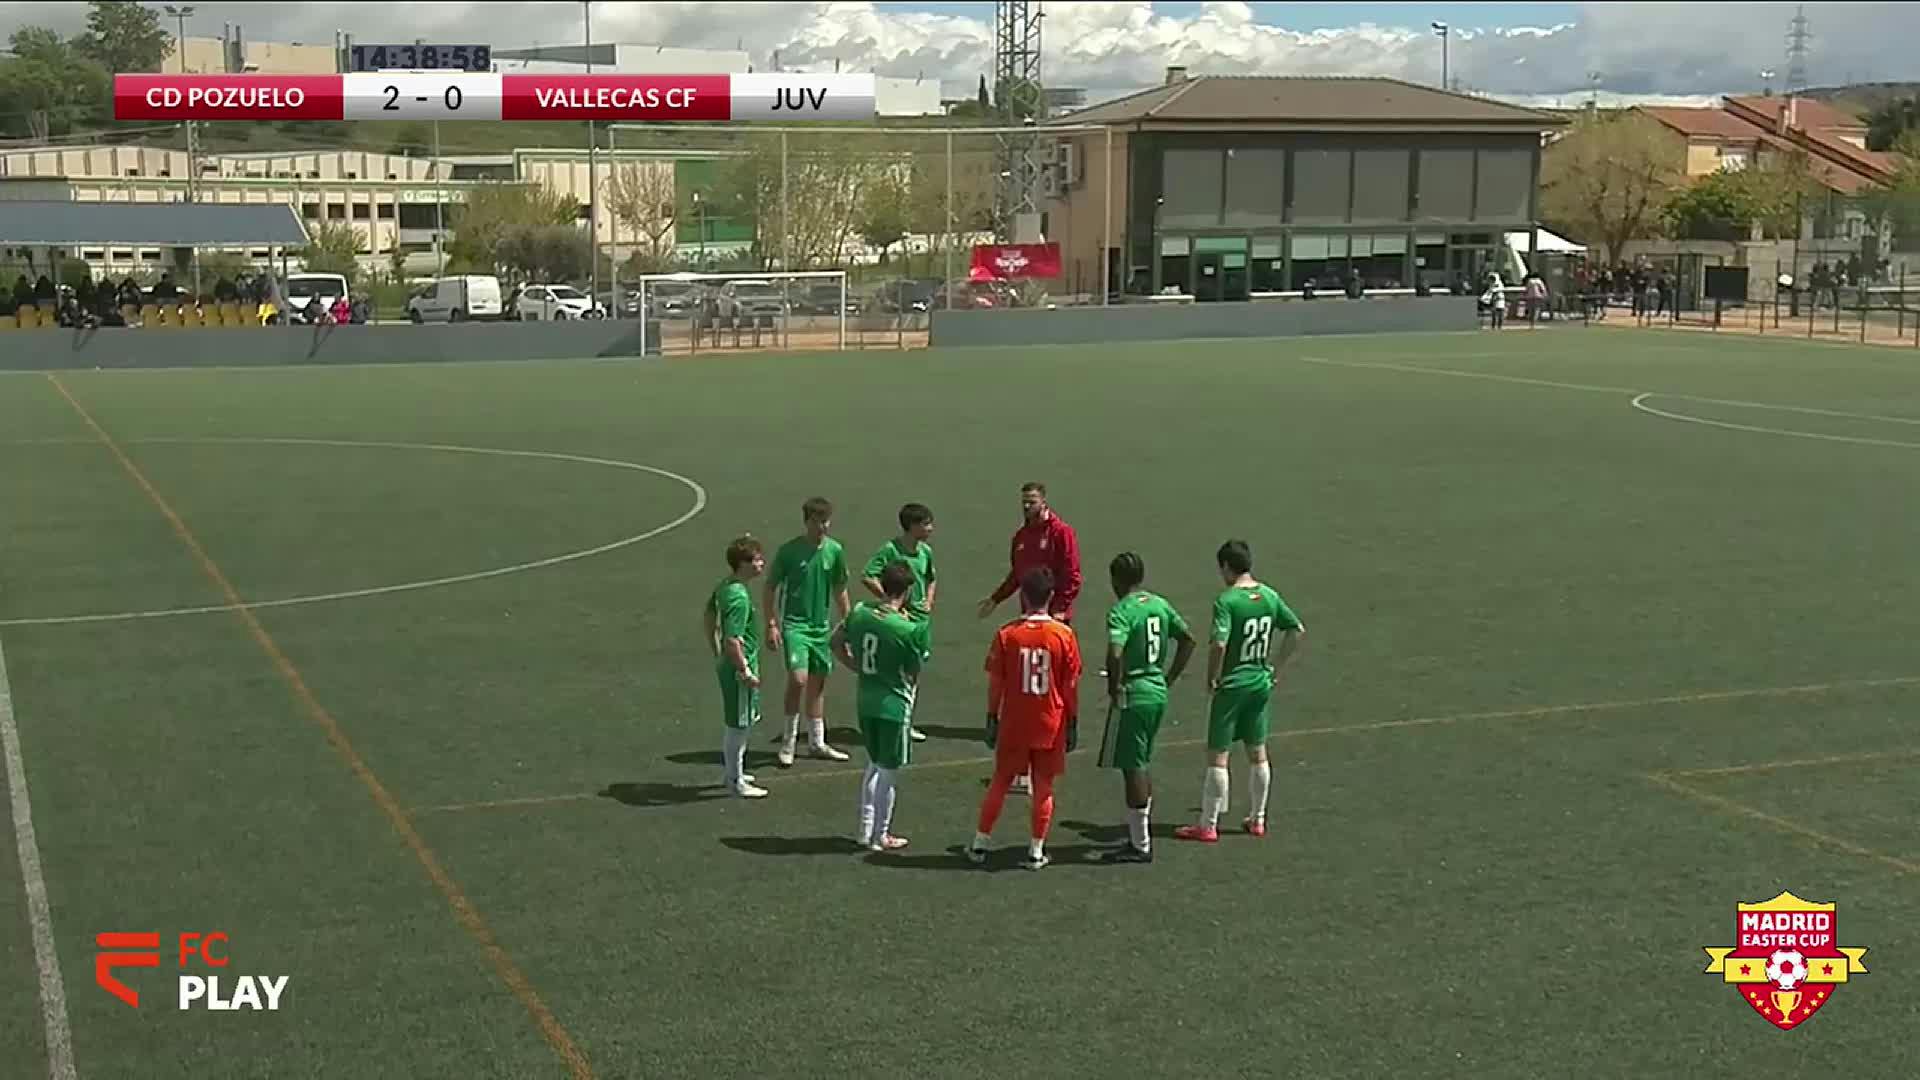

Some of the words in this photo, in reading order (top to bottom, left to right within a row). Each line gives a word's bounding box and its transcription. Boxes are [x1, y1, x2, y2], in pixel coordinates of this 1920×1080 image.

[862, 633, 879, 674] 8
[1240, 616, 1271, 662] 23
[1018, 648, 1050, 695] 13
